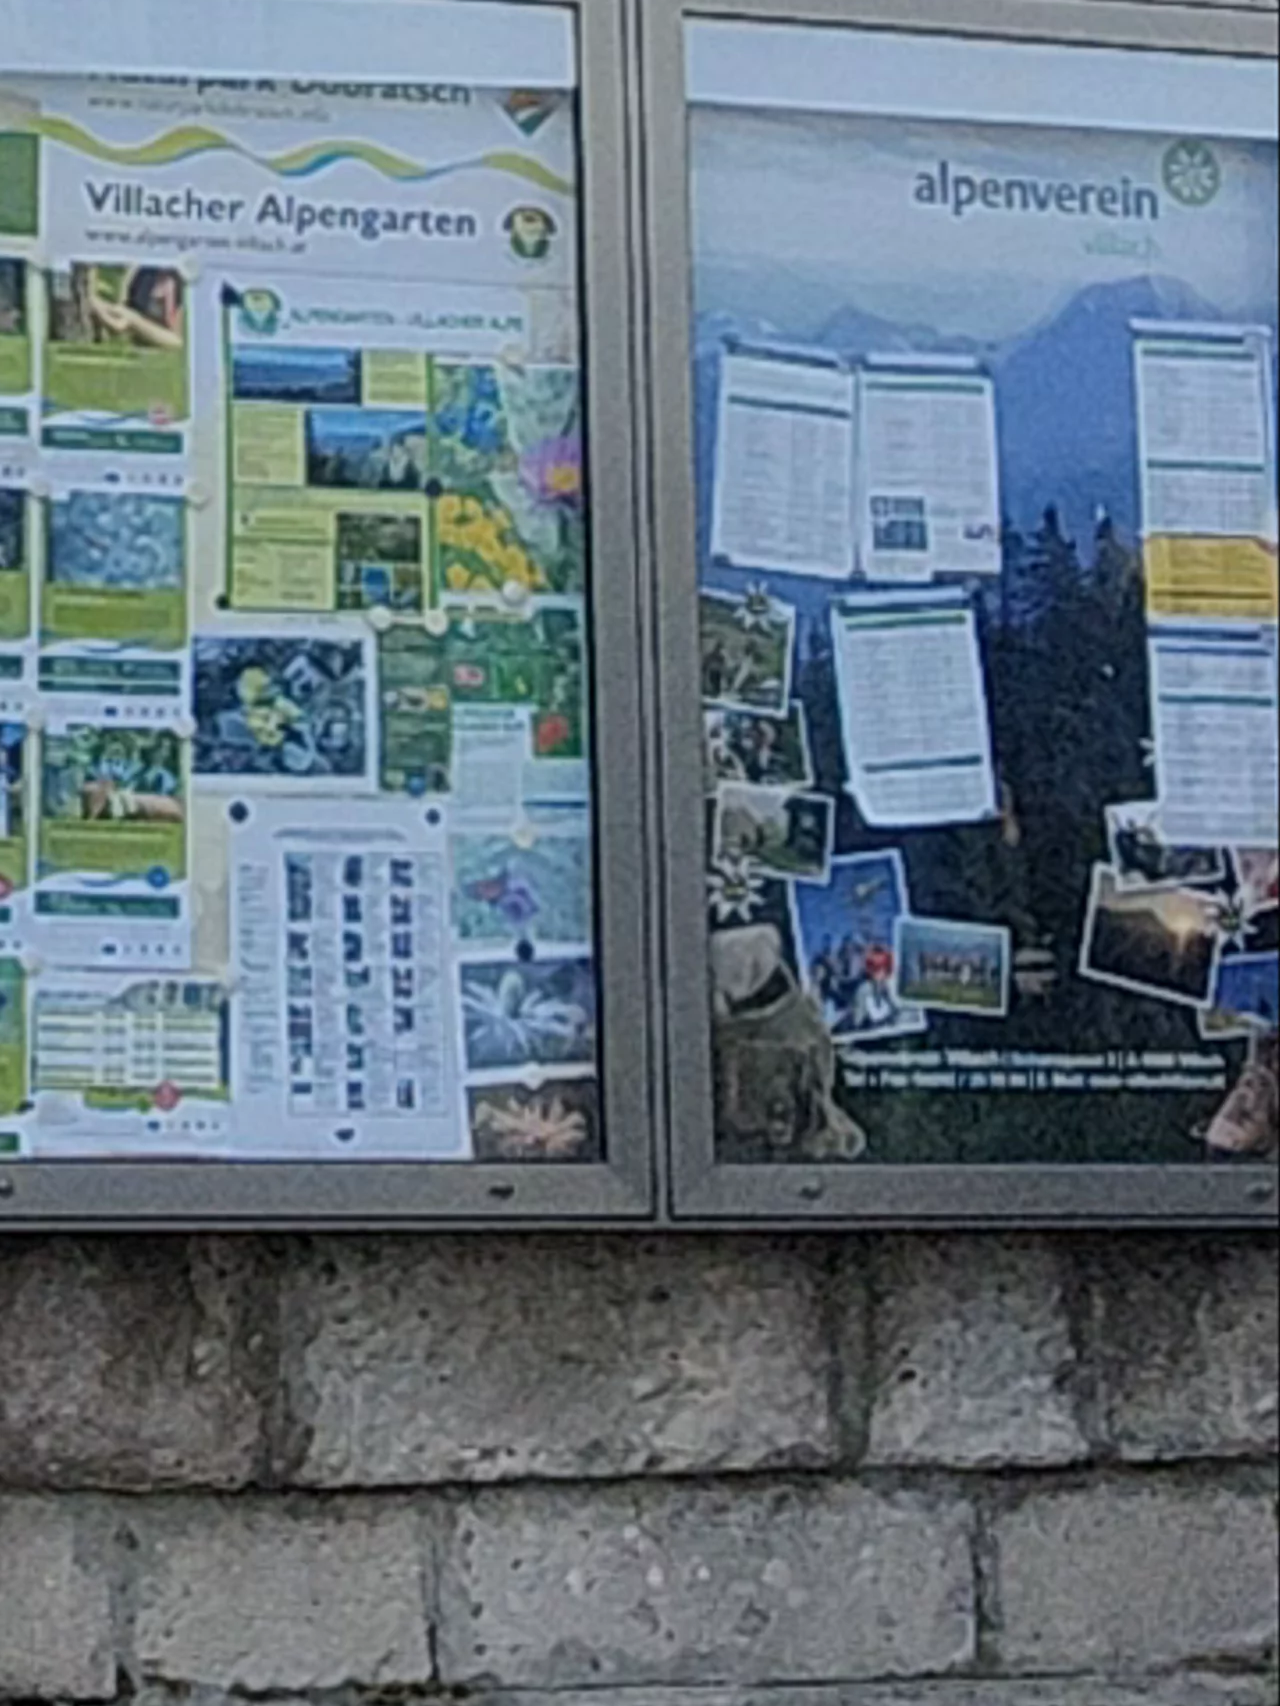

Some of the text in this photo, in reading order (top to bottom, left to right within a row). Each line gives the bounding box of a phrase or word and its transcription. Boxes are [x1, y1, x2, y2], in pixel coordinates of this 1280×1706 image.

[85, 181, 477, 240] Villacher Alpengarten
[913, 159, 1159, 221] alpenverein
